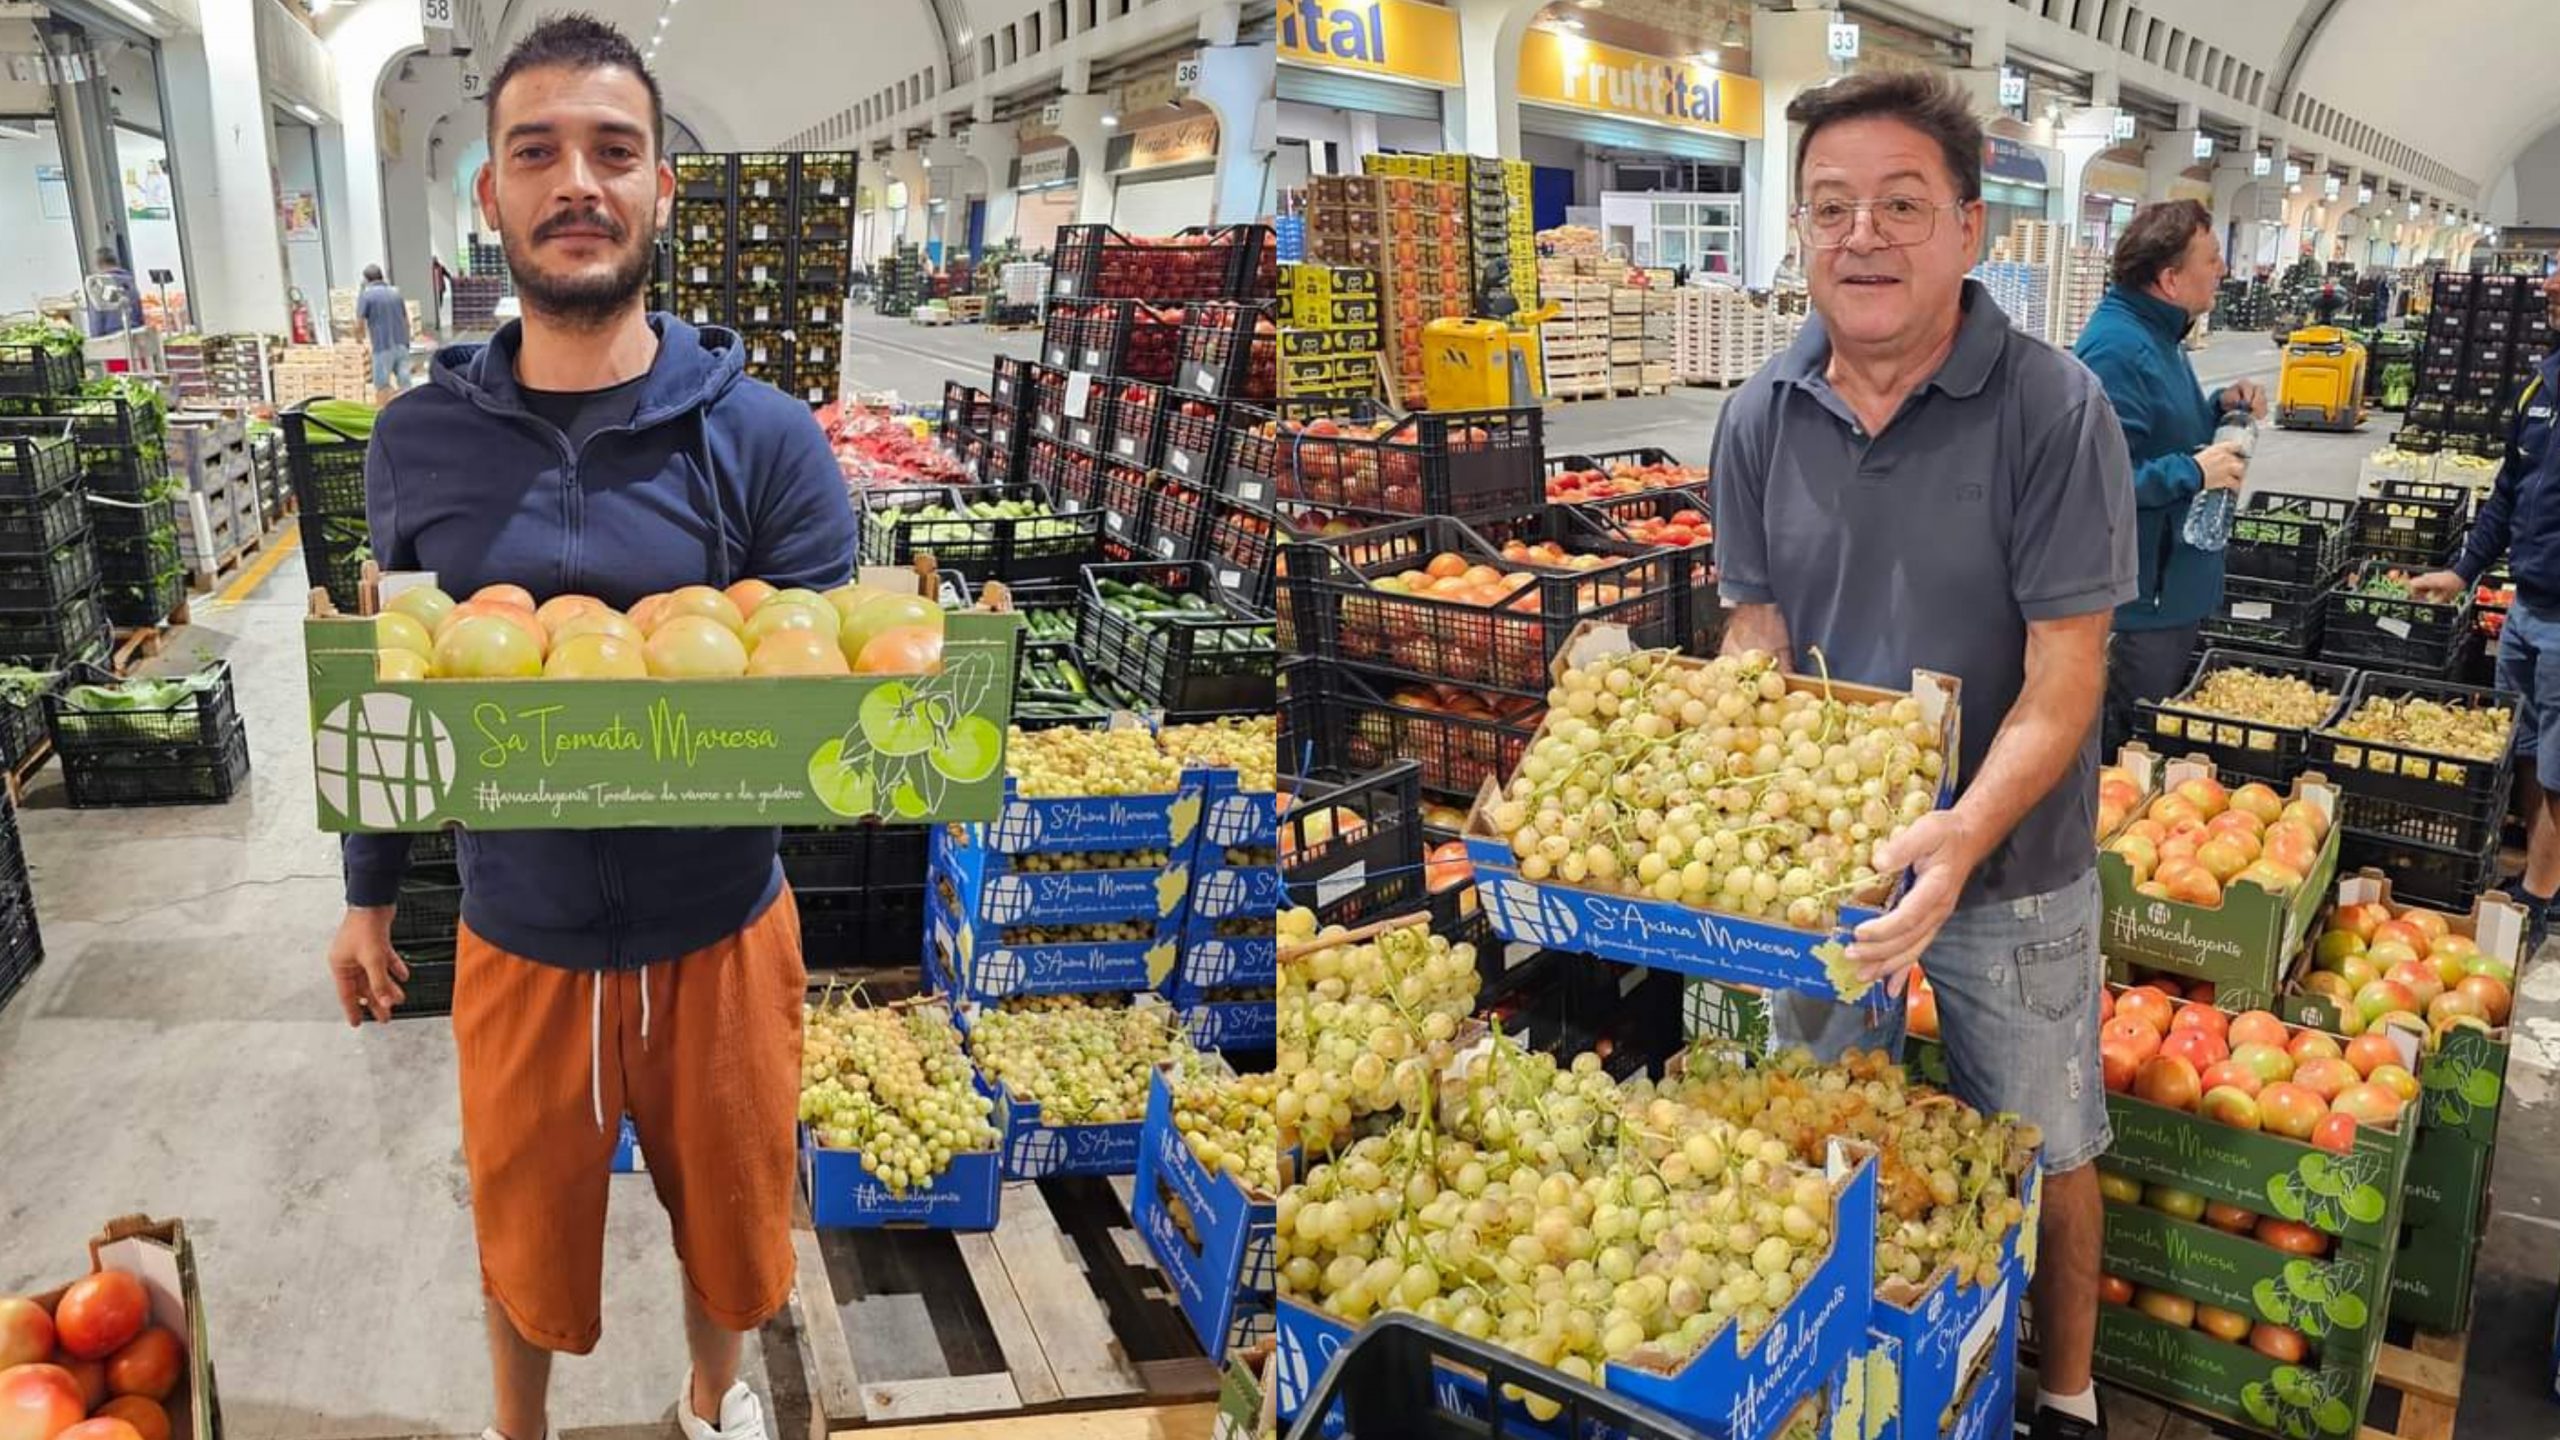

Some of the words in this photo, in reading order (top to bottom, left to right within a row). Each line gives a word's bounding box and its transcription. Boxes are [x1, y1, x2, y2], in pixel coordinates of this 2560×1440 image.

[426, 0, 449, 20] 58
[1833, 30, 1855, 51] 33
[464, 73, 480, 92] 57
[1178, 64, 1199, 82] 36
[1045, 107, 1061, 121] 37
[473, 702, 528, 768] Sa
[516, 704, 643, 768] Tomata
[648, 696, 780, 768] Maresa
[1697, 916, 1802, 961] Maresa
